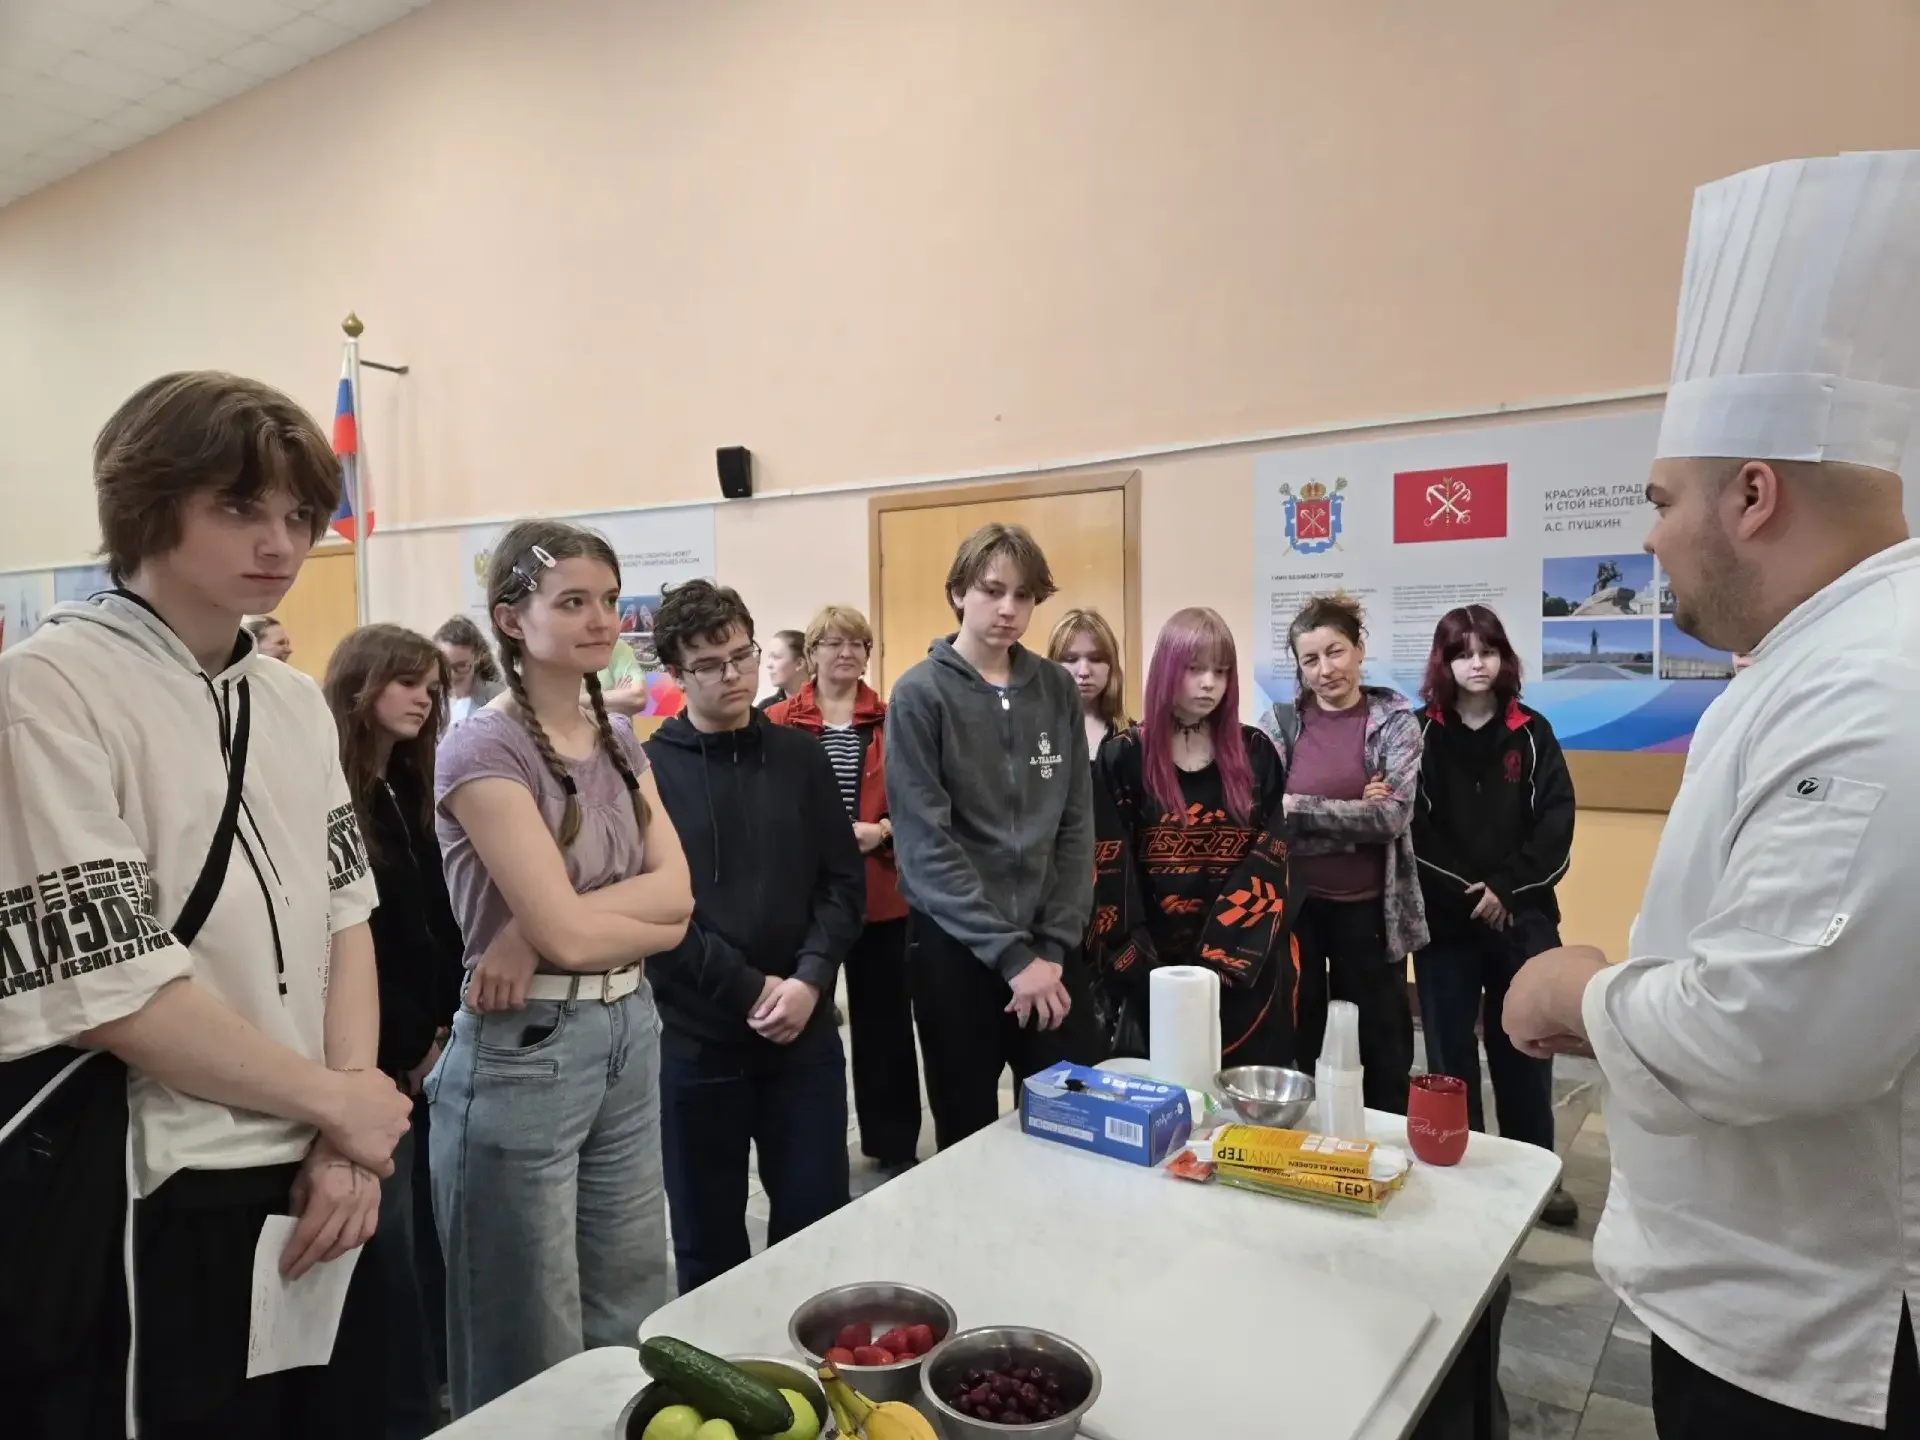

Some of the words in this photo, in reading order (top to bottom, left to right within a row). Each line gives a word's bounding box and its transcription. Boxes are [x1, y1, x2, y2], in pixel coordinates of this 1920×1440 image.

[1545, 486, 1609, 501] КРАСУЙСЯ,
[1612, 483, 1644, 496] ГРАД
[1545, 502, 1553, 512] И
[1556, 499, 1586, 511] СТОЙ
[1589, 495, 1649, 508] НЕКОЛЕБ
[1568, 518, 1622, 531] ПУШКИН
